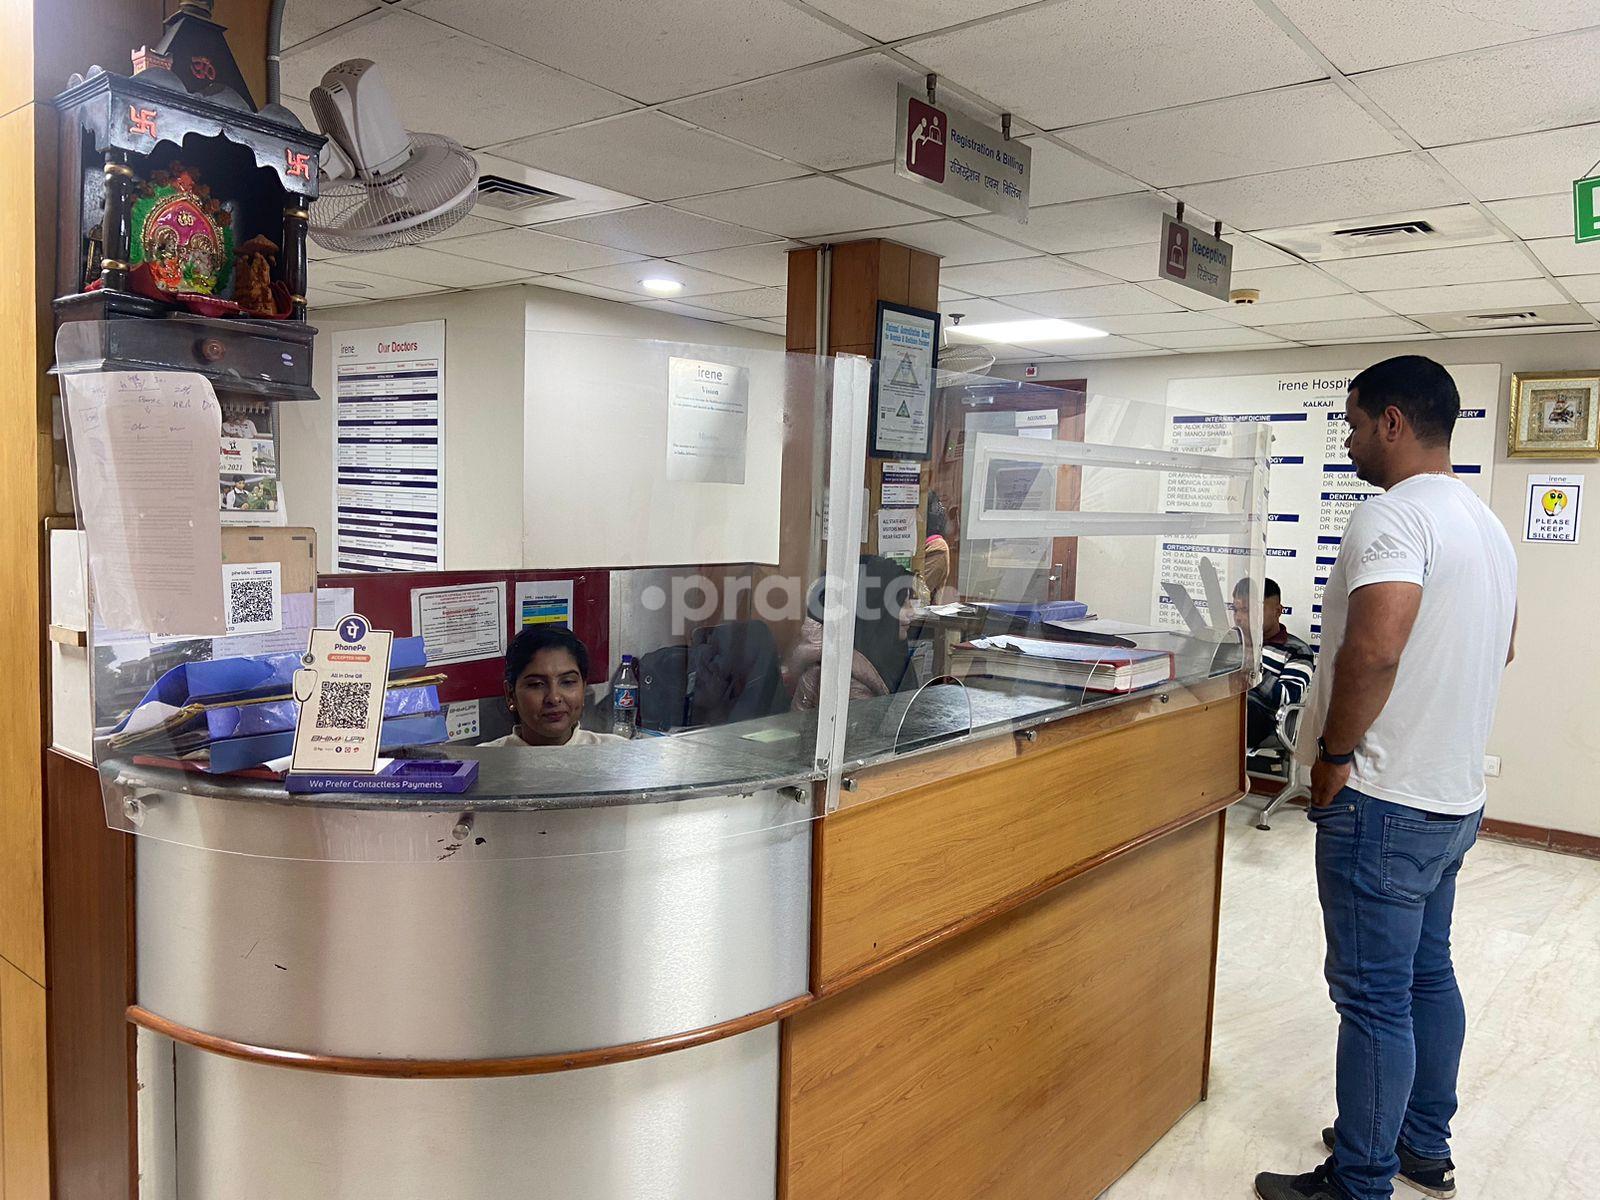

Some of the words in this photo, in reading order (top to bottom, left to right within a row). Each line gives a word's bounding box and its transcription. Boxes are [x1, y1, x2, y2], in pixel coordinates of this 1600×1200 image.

[951, 128, 994, 158] Registration
[996, 150, 1001, 161] &
[1003, 153, 1024, 174] Billing
[1192, 237, 1226, 265] Reception
[341, 344, 355, 354] irene
[378, 343, 390, 353] Our
[391, 341, 418, 352] Doctors
[697, 366, 723, 380] irene
[1278, 380, 1308, 391] irene
[1312, 377, 1351, 390] Hospit
[1361, 551, 1407, 563] adidas
[346, 621, 359, 639] पे
[334, 644, 366, 652] PhonePe
[310, 780, 324, 788] We
[325, 780, 352, 788] Prefer
[353, 780, 400, 788] Contactless
[402, 781, 443, 790] Payments
